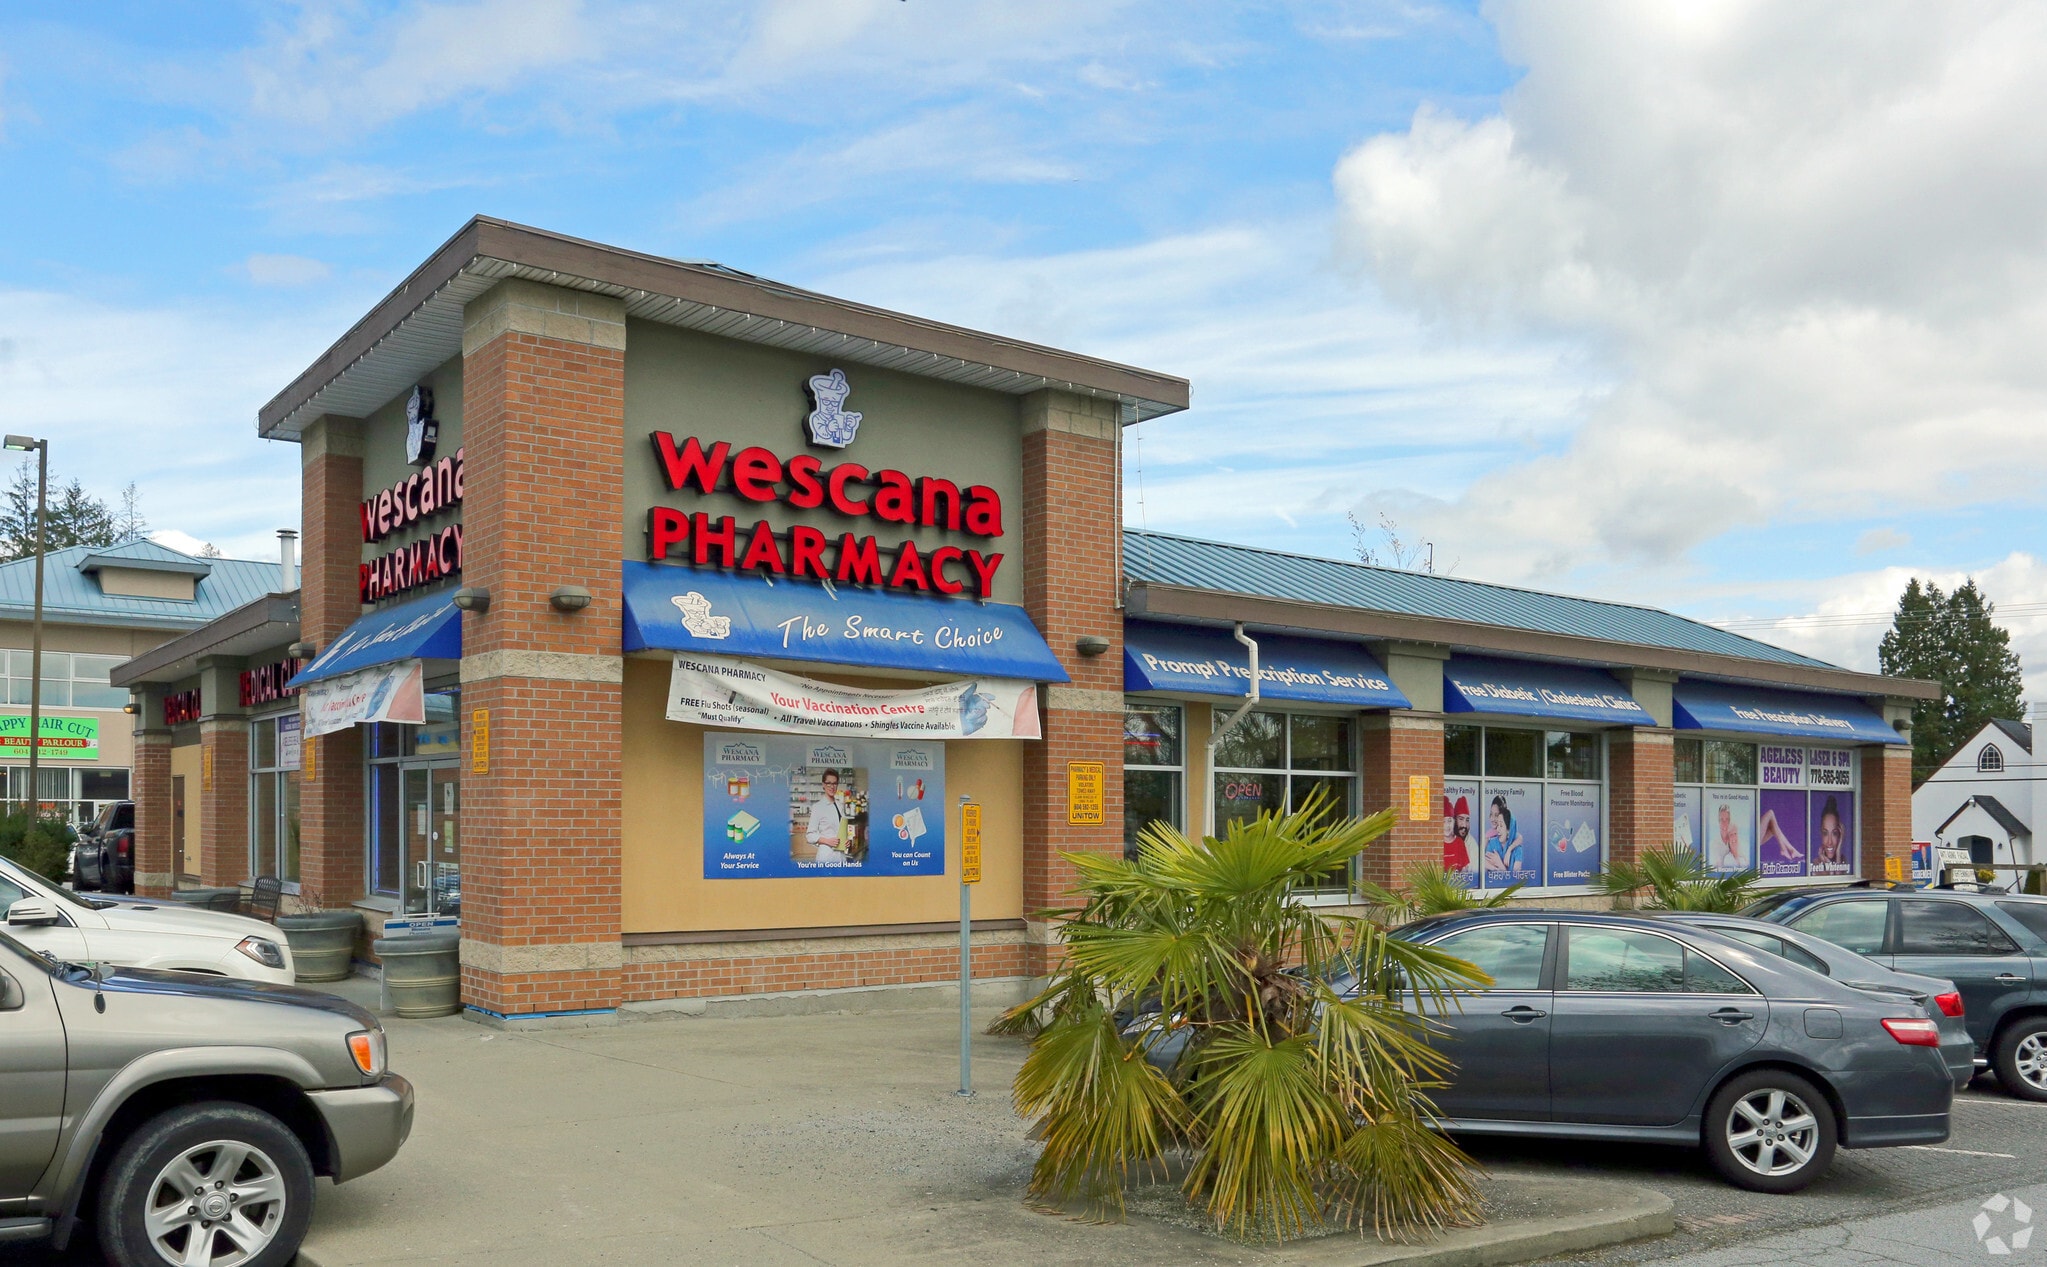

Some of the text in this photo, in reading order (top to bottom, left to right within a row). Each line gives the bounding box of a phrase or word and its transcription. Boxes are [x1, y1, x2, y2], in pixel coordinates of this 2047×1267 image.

[649, 506, 1004, 599] PHARMACY
[360, 524, 463, 603] PHARMACY
[777, 616, 1003, 649] The Smart Choice
[678, 660, 766, 682] WESCANA PHARMACY
[1142, 654, 1389, 691] Prompt Precription Service
[240, 663, 277, 707] MEDICAL
[812, 686, 861, 698] Appointments
[1453, 680, 1486, 698] Free
[1482, 683, 1539, 702] Diabetic
[1602, 694, 1641, 711] Clinics
[680, 698, 769, 715] FREE Flu Shots (seasonal)
[771, 692, 800, 709] Your
[802, 697, 879, 715] Vaccination
[881, 704, 925, 715] Centre
[780, 714, 955, 731] All Travel Vaccinations Shingles Vaccine Available
[1729, 705, 1855, 731] Free Prescription Delivery
[67, 723, 94, 738] CUT
[4, 738, 40, 746] BEAUT
[42, 739, 83, 747] PARLOUR
[721, 754, 760, 763] PHARMACY
[723, 748, 759, 757] WESCANA
[812, 751, 847, 759] WESCANA
[896, 753, 928, 761] WESCANA
[1760, 747, 1803, 765] AGELESS
[1809, 750, 1830, 766] LASER
[1838, 751, 1850, 767] SPA
[811, 757, 848, 765] PHARMACY
[894, 759, 930, 768] PHARMACY
[1763, 766, 1800, 784] BEAUTY
[1225, 783, 1262, 799] OPEN
[1459, 787, 1476, 796] Family
[1493, 788, 1509, 796] Happy
[1509, 788, 1525, 797] Family
[1570, 800, 1594, 808] Monitoring
[723, 853, 746, 861] Always
[797, 861, 817, 869] You're
[1762, 863, 1776, 874] Hair
[1776, 862, 1801, 875] Removal
[1810, 862, 1850, 873] Teeth Whitening
